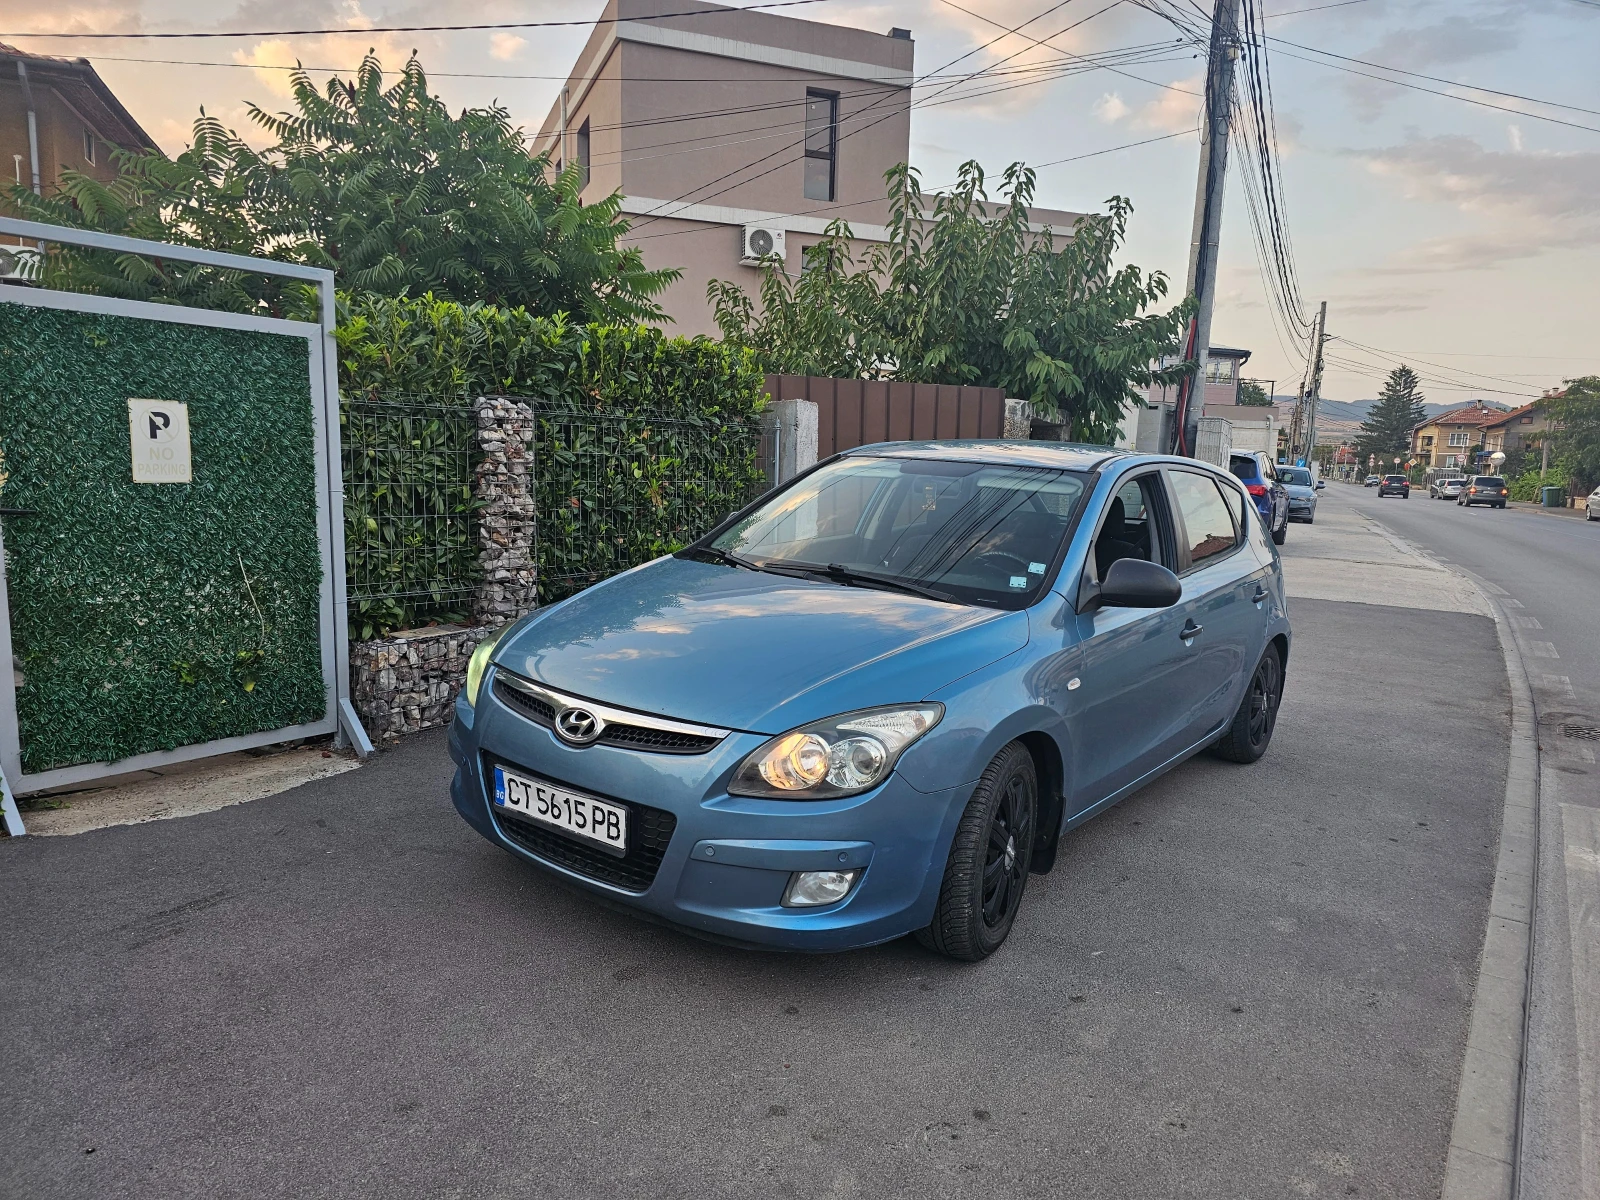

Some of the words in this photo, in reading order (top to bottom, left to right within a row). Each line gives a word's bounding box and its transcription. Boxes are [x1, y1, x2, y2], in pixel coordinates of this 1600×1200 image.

[148, 411, 171, 439] P
[149, 447, 174, 460] NO
[137, 463, 186, 475] PARKING
